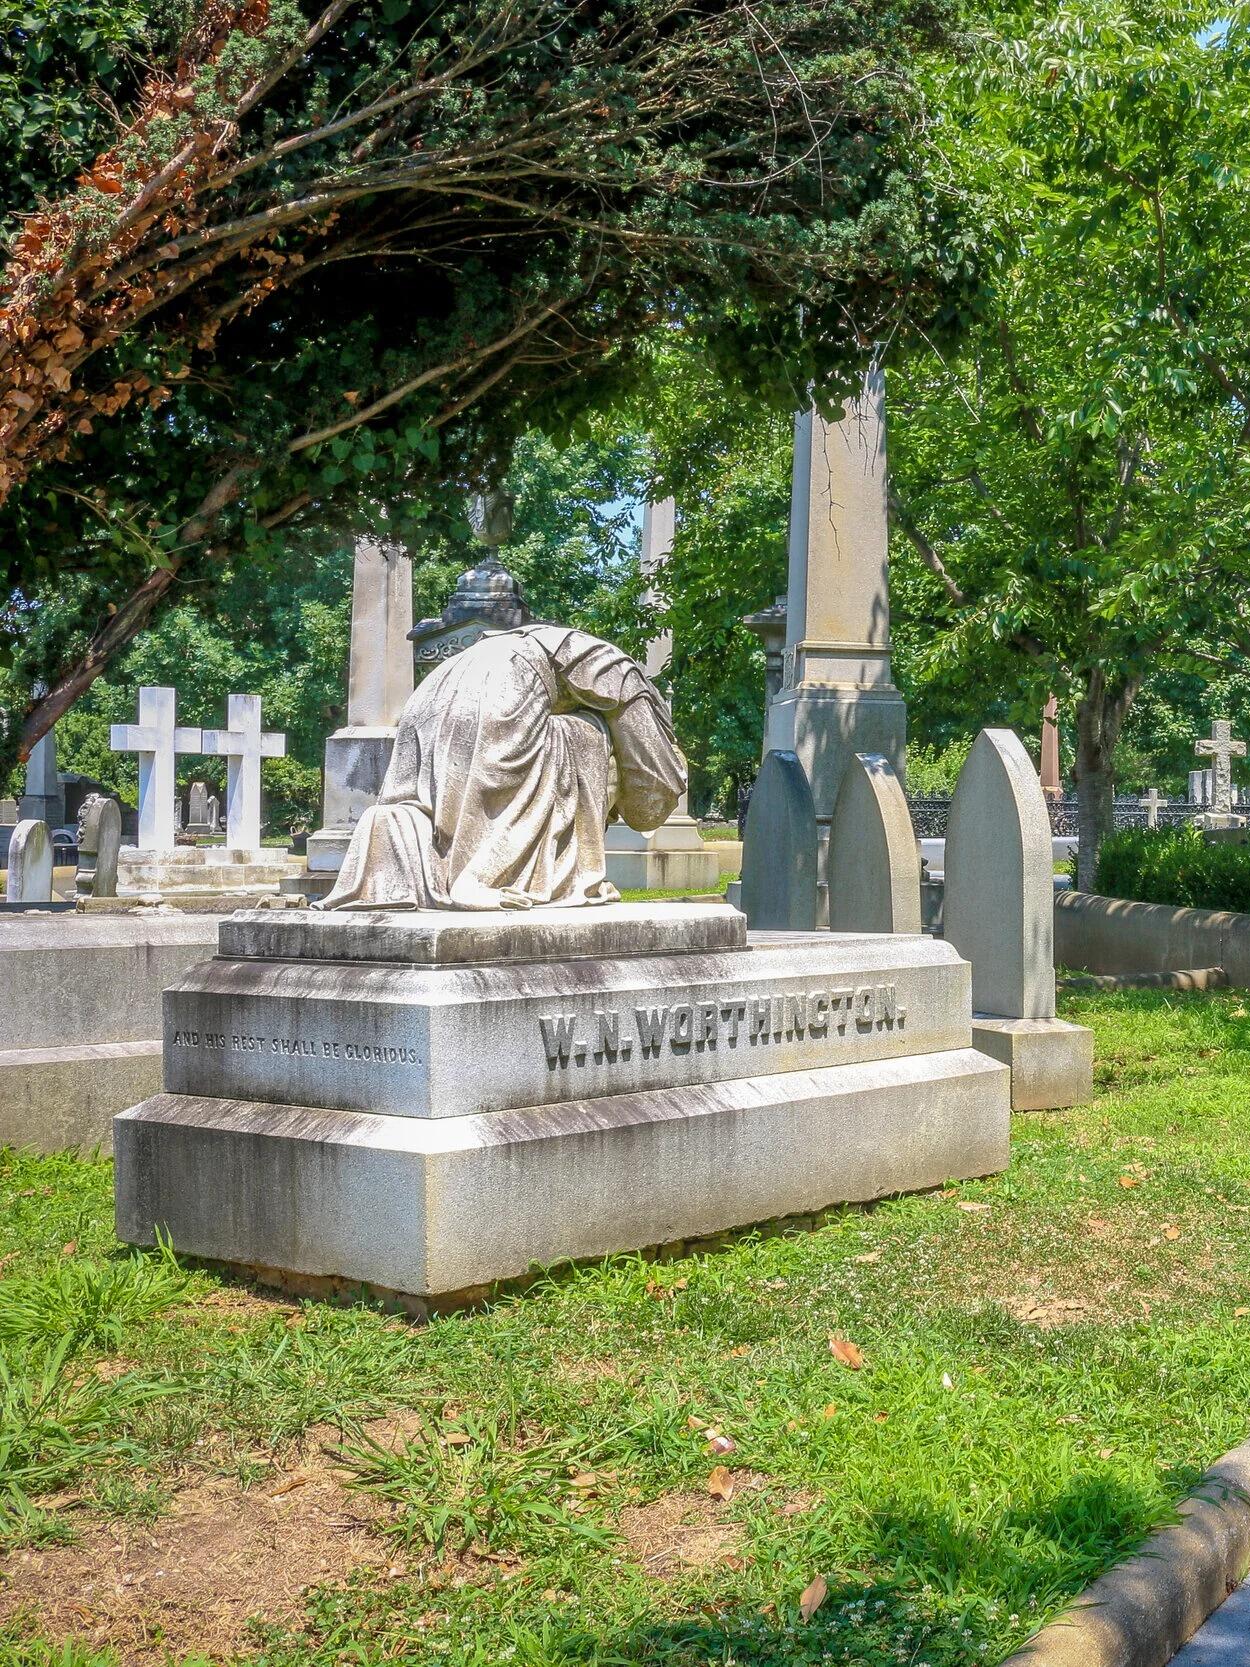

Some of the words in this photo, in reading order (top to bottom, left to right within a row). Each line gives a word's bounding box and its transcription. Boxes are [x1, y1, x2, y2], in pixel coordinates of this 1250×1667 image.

[173, 1030, 200, 1047] AND
[205, 1033, 226, 1049] HIS
[231, 1035, 265, 1053] REST
[271, 1038, 317, 1058] SHALL
[322, 1042, 340, 1060] BE
[344, 1044, 423, 1066] GLORIOUS.
